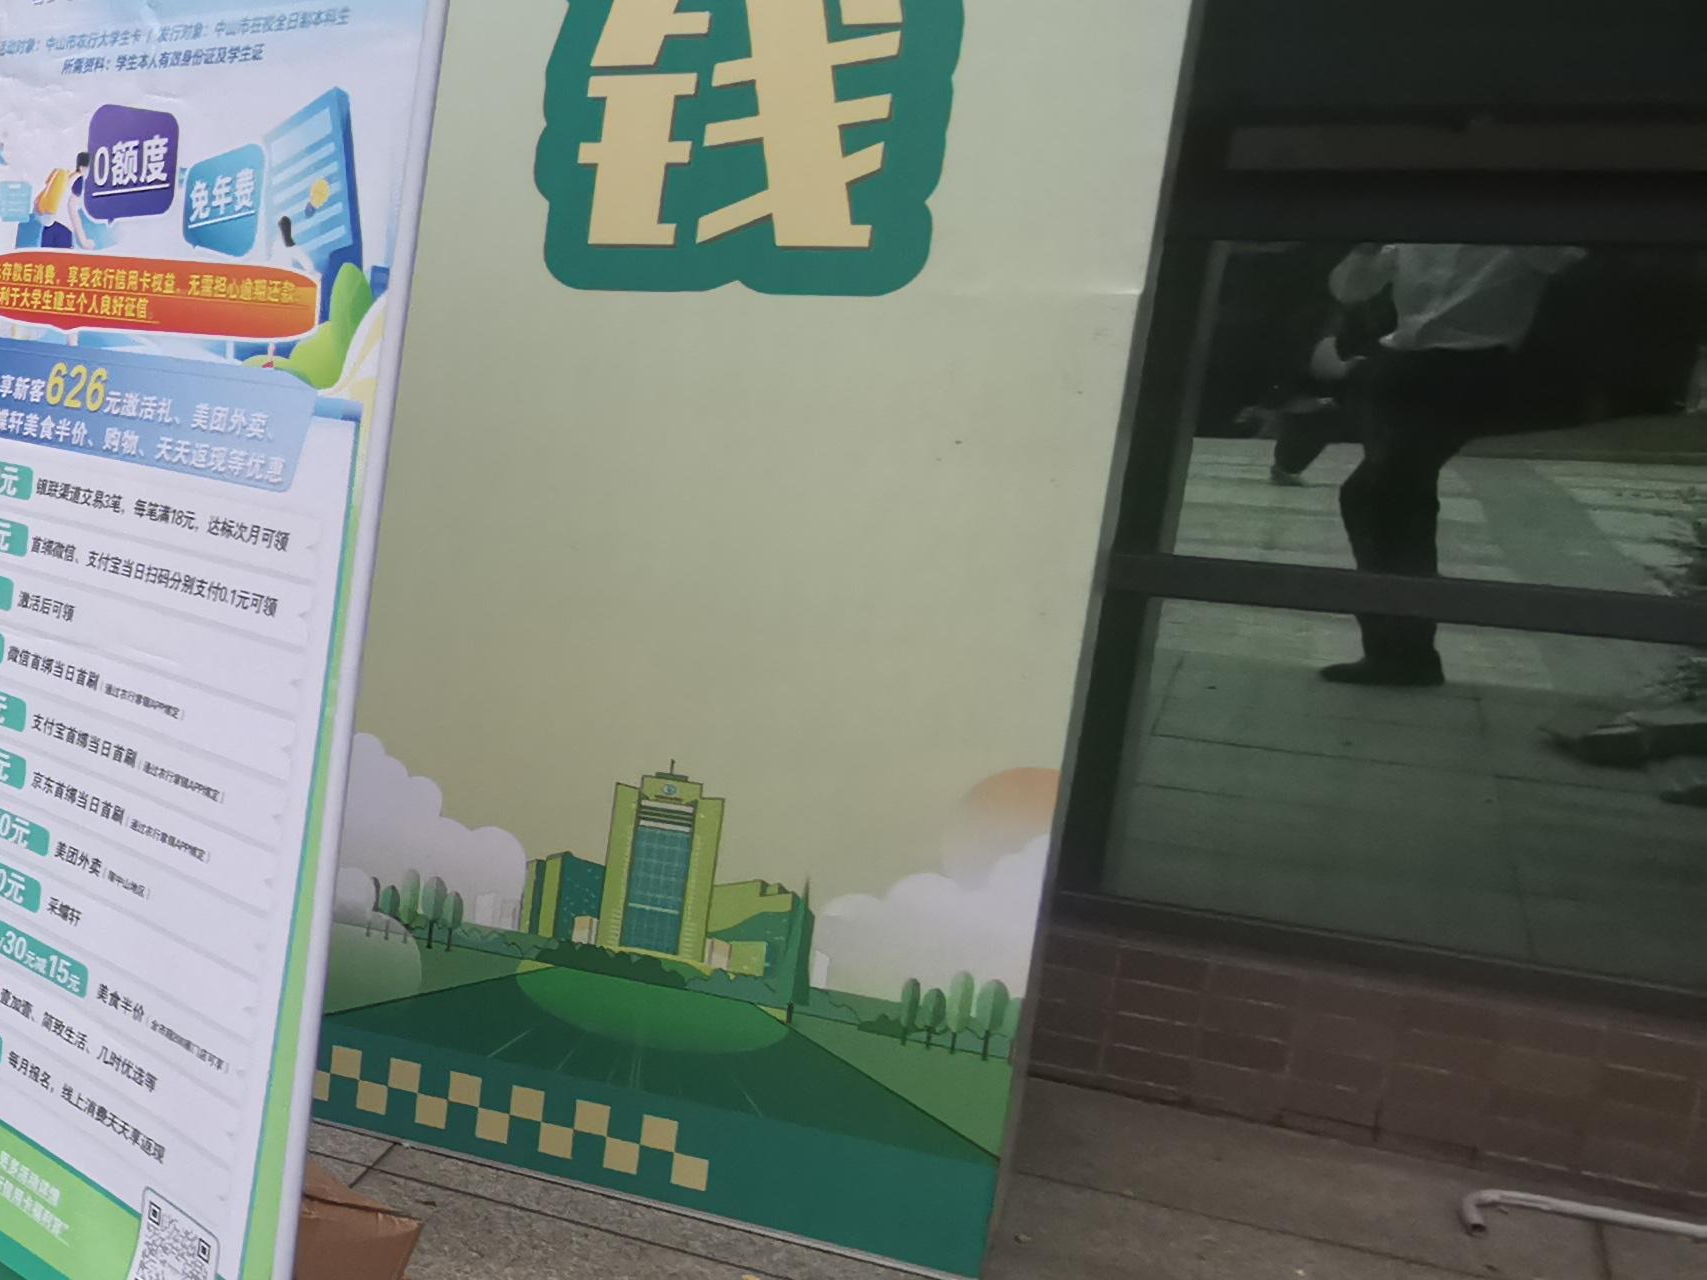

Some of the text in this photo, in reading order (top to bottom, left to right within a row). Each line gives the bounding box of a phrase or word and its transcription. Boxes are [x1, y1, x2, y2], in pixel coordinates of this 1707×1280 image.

[93, 134, 169, 187] 0额度
[188, 168, 256, 222] 免年费
[17, 590, 76, 623] 激活后可领
[52, 841, 103, 878] 美团外卖
[95, 982, 146, 1025] 美食半价
